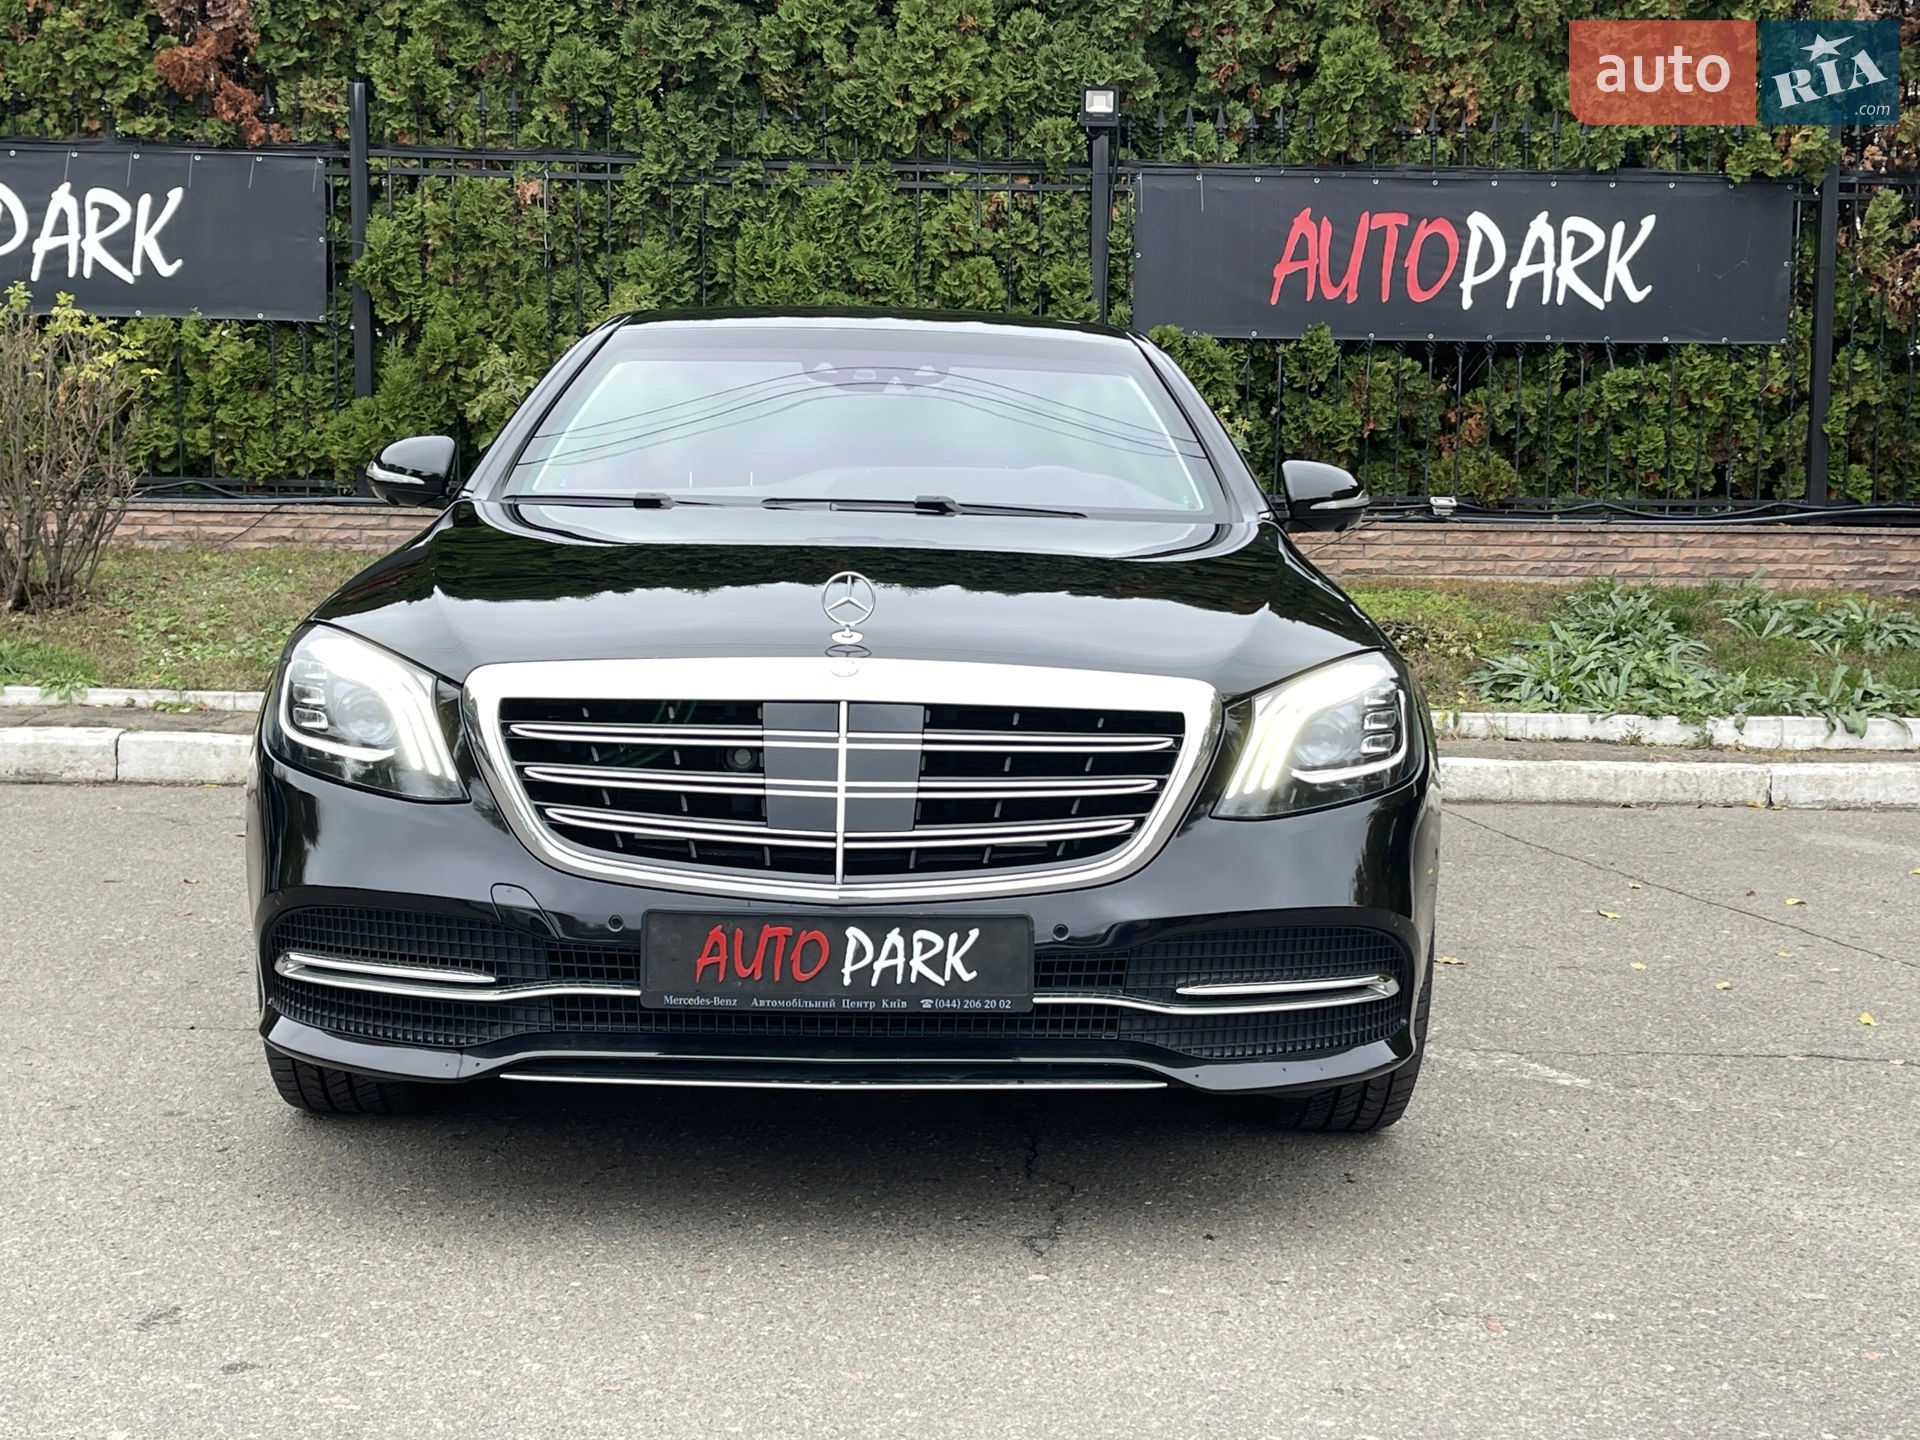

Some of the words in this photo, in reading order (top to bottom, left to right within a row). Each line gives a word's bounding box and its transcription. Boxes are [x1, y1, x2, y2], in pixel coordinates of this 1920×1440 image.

[695, 924, 830, 983] AUTO
[840, 926, 981, 987] PARK
[663, 995, 738, 1007] Mercedes-Benz
[751, 997, 836, 1009] Автомобільний
[842, 999, 876, 1010] Центр
[881, 999, 908, 1009] Київ
[934, 999, 961, 1010] (044)
[963, 999, 982, 1009] 206
[983, 999, 997, 1009] 20
[998, 999, 1012, 1009] 02
